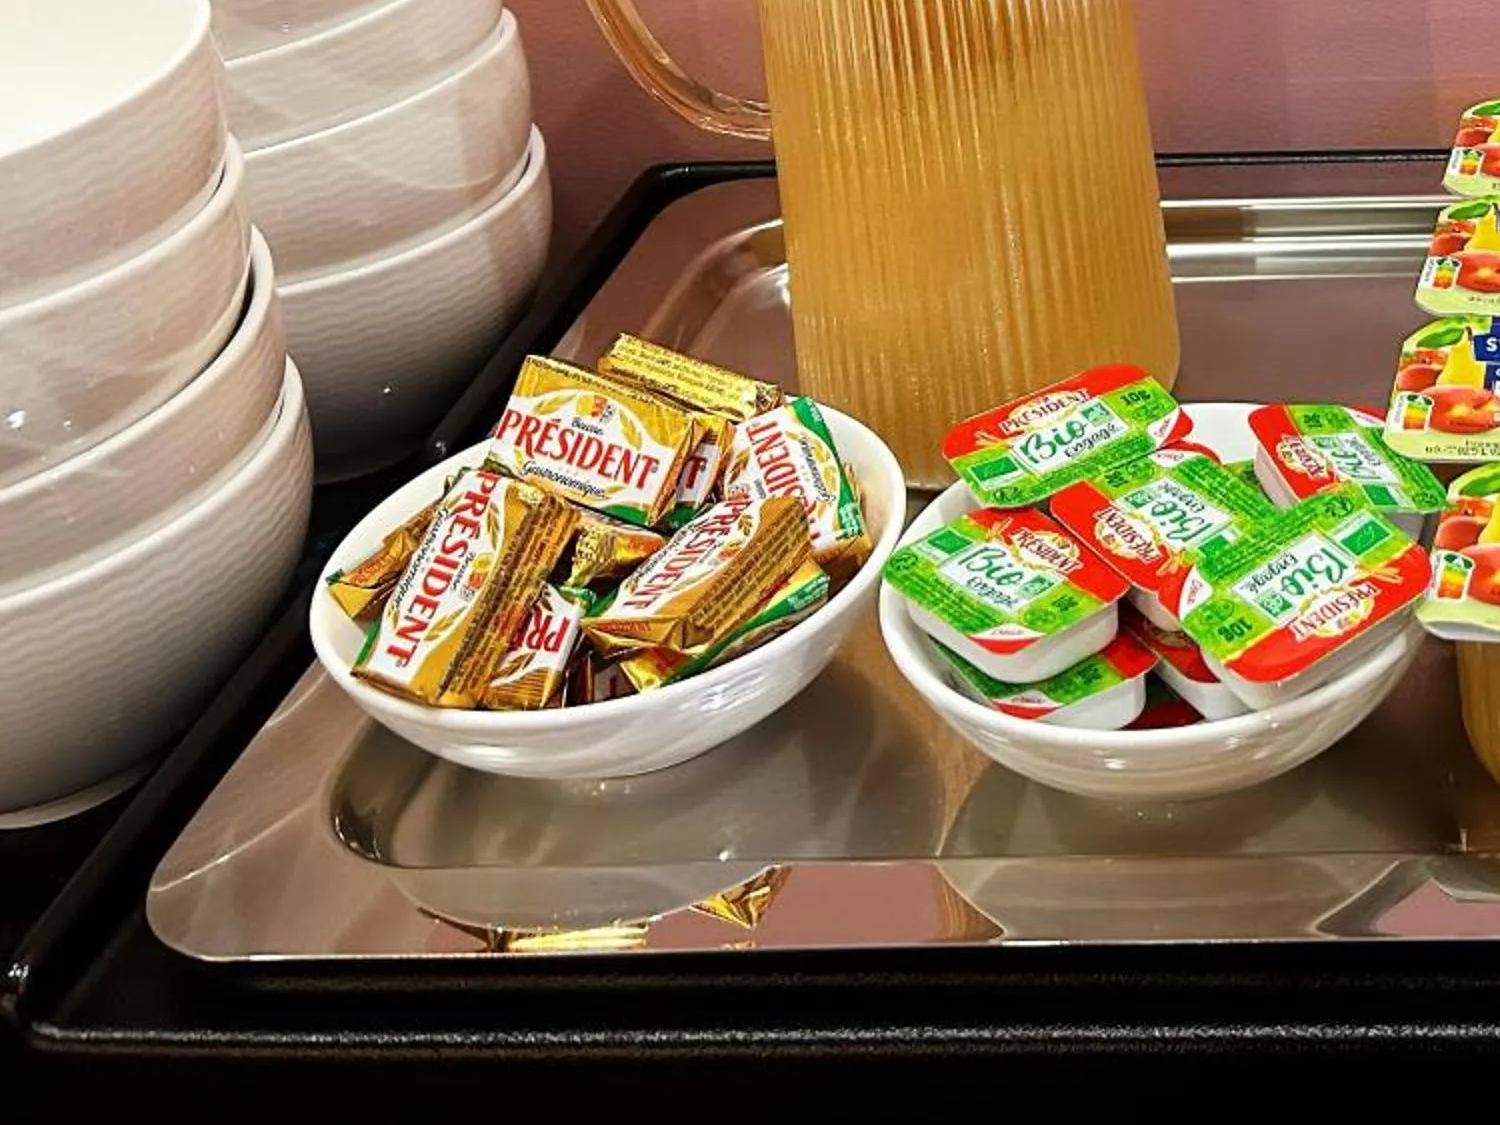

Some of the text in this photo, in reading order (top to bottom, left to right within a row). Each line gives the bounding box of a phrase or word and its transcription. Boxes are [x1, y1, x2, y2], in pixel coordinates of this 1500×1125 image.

[496, 409, 660, 490] PRÉSIDENT
[1019, 419, 1086, 464] Bio
[387, 465, 499, 669] PRÉSIDENT
[958, 545, 1025, 586] Bio
[1248, 552, 1300, 594] Engagé
[1281, 547, 1350, 597] Bio
[1291, 581, 1379, 638] PRÉSIDENT
